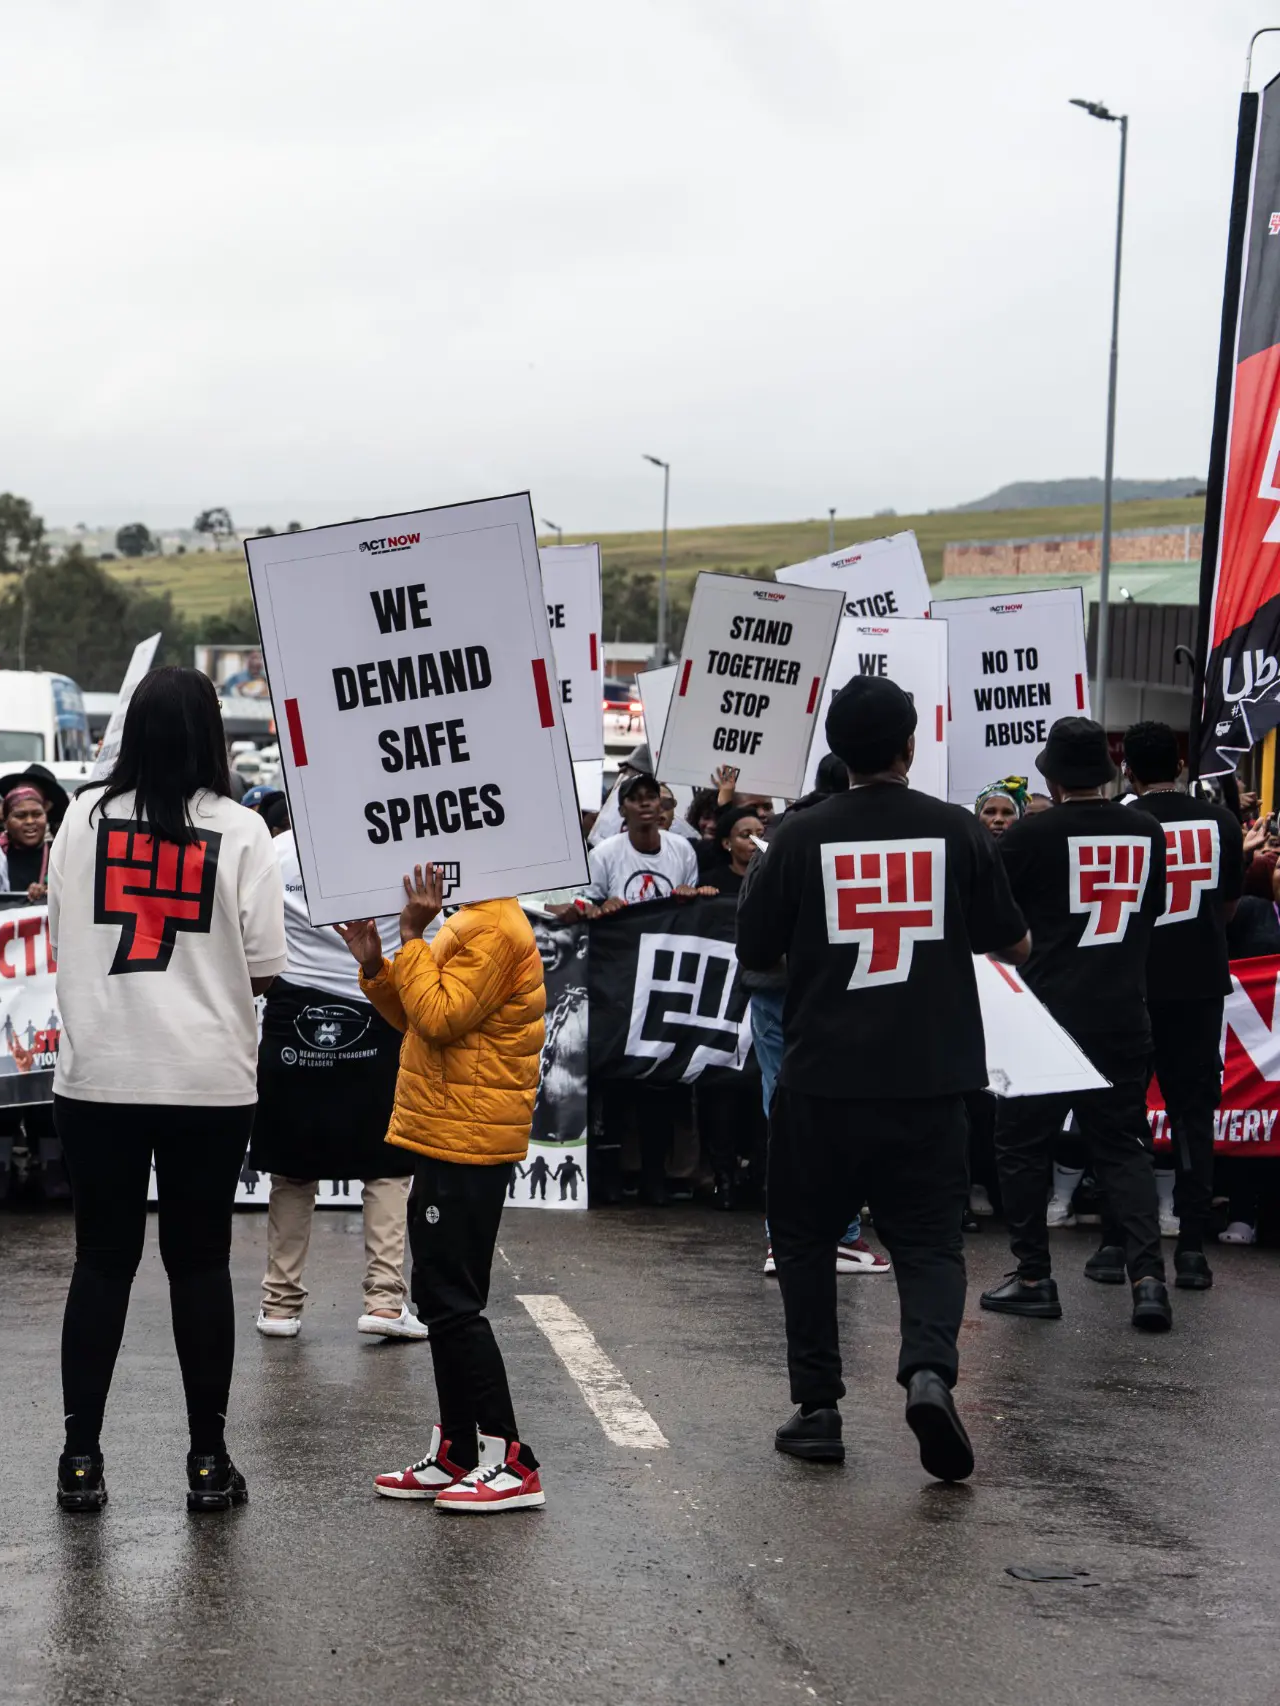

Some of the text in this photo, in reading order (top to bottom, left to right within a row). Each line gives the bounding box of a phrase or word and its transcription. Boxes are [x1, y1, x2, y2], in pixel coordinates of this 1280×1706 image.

[359, 538, 386, 552] ACT
[387, 532, 421, 548] NOW
[370, 583, 432, 635] WE
[844, 591, 898, 617] STICE
[729, 616, 793, 647] STAND
[707, 650, 801, 686] TOGETHER
[858, 653, 888, 677] WE
[982, 647, 1038, 674] NO TO
[1222, 649, 1280, 701] Ub
[332, 645, 492, 711] DEMAND
[720, 690, 770, 719] STOP
[974, 682, 1052, 711] WOMEN
[377, 718, 470, 773] SAFE
[712, 726, 764, 757] GBVF
[985, 719, 1047, 747] ABUSE
[364, 783, 506, 845] SPACES
[299, 1049, 337, 1060] MEANINGFUL
[338, 1047, 378, 1060] ENGAGEMENT
[299, 1058, 306, 1066] OF
